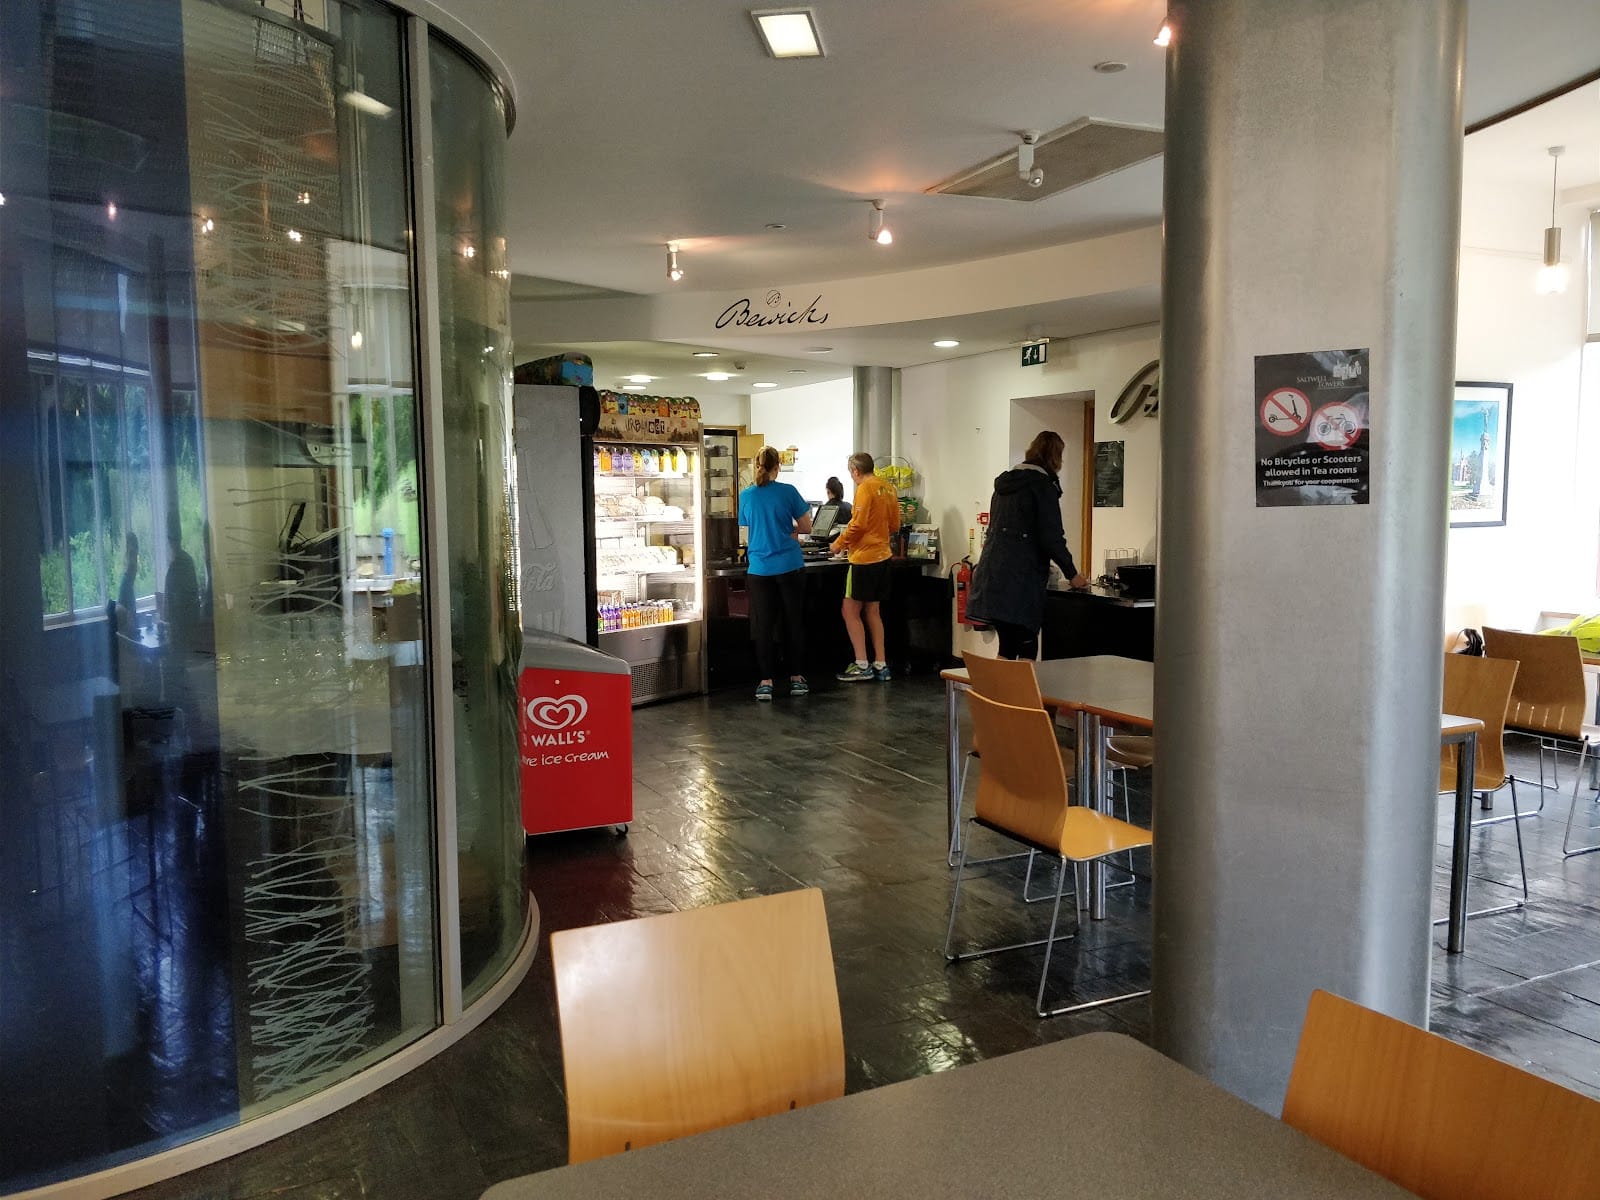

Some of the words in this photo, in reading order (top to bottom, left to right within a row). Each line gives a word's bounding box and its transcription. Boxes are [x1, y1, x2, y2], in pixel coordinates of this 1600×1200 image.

[715, 294, 829, 329] Bewicks
[1260, 458, 1273, 466] No
[1274, 457, 1310, 468] Bicycles
[1312, 457, 1322, 465] or
[1323, 455, 1362, 465] Scooters
[1265, 467, 1301, 477] allowed
[1302, 466, 1311, 475] in
[1312, 466, 1328, 475] Tea
[1329, 466, 1358, 475] rooms
[531, 731, 585, 747] WALL'S
